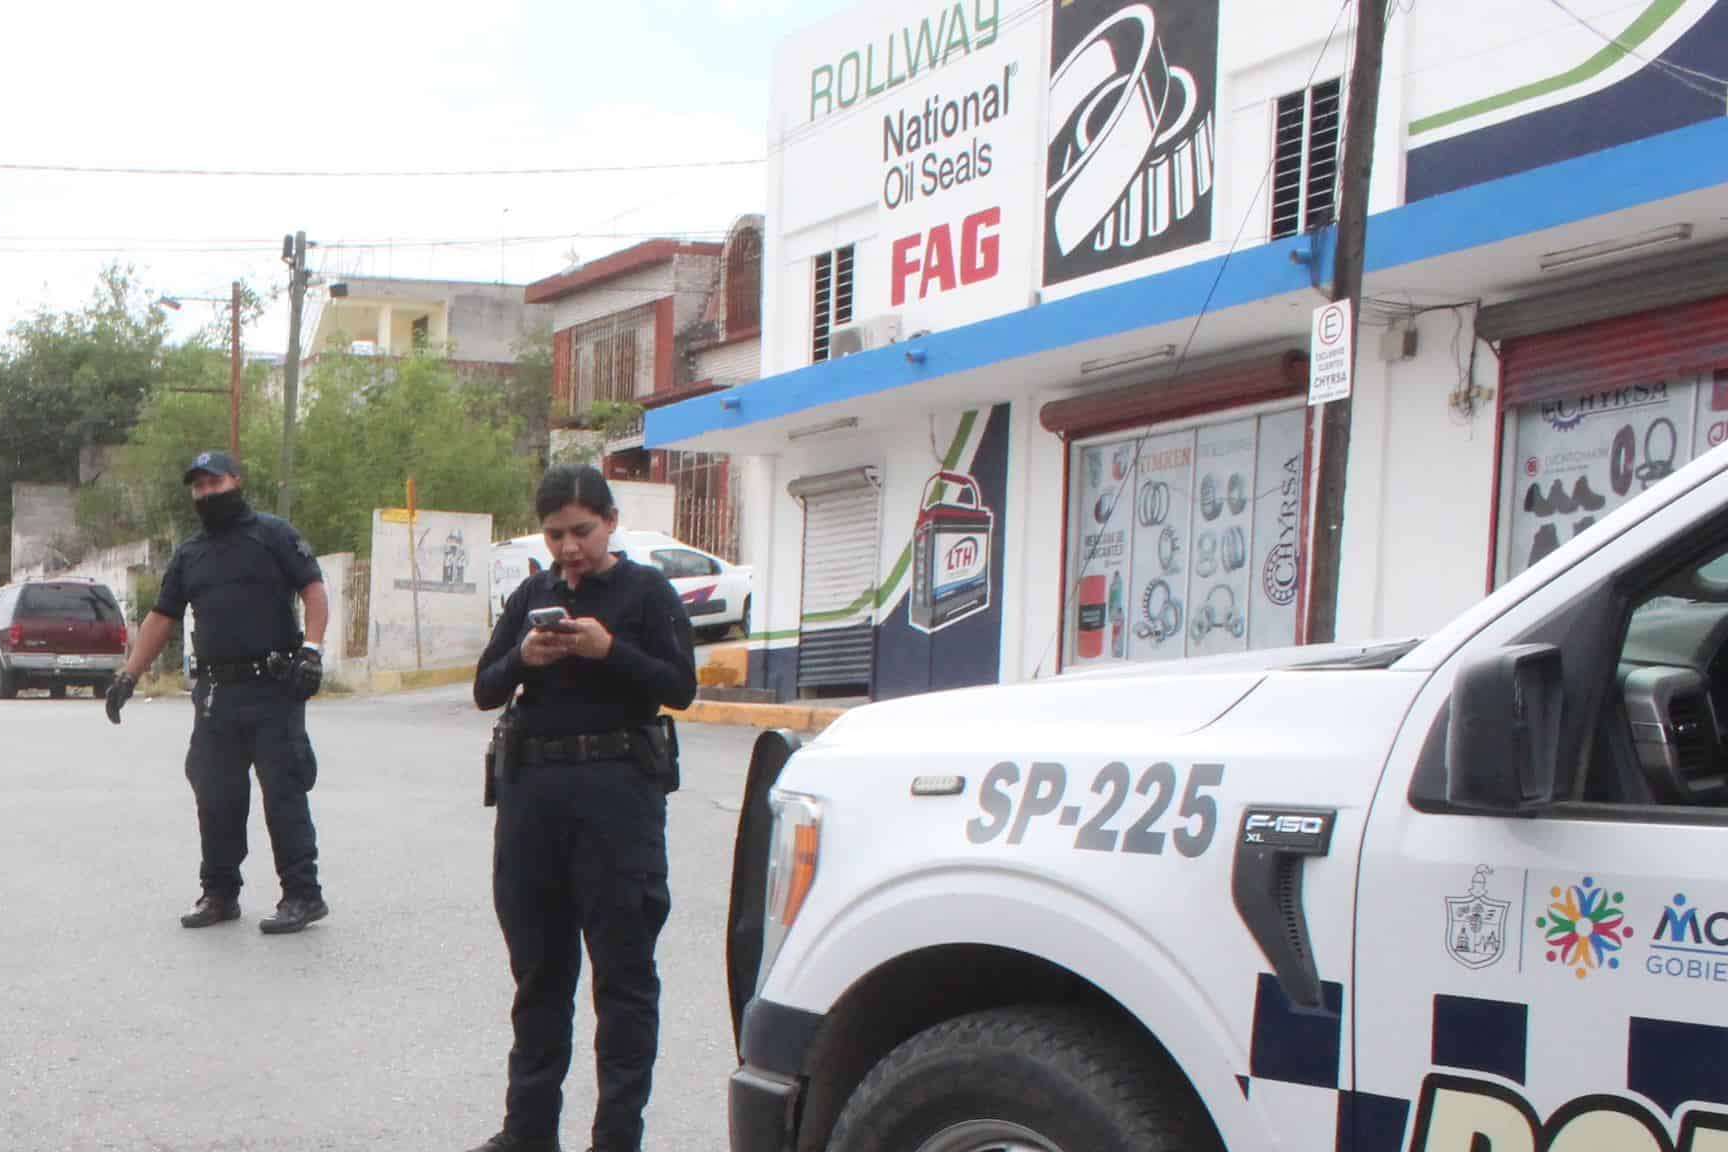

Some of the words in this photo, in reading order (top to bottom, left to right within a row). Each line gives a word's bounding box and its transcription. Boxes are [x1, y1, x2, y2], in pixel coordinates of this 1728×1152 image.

[810, 0, 1000, 122] ROLLWAY
[884, 159, 915, 210] Oil
[920, 141, 993, 197] Seals
[891, 205, 1001, 306] FAG
[1325, 312, 1336, 338] E
[1313, 371, 1347, 389] CHYRSA
[1275, 454, 1299, 588] CHYRSA
[945, 547, 974, 570] LTH
[966, 760, 1225, 859] SP-225
[1245, 814, 1324, 834] F-150
[1245, 833, 1265, 843] XL
